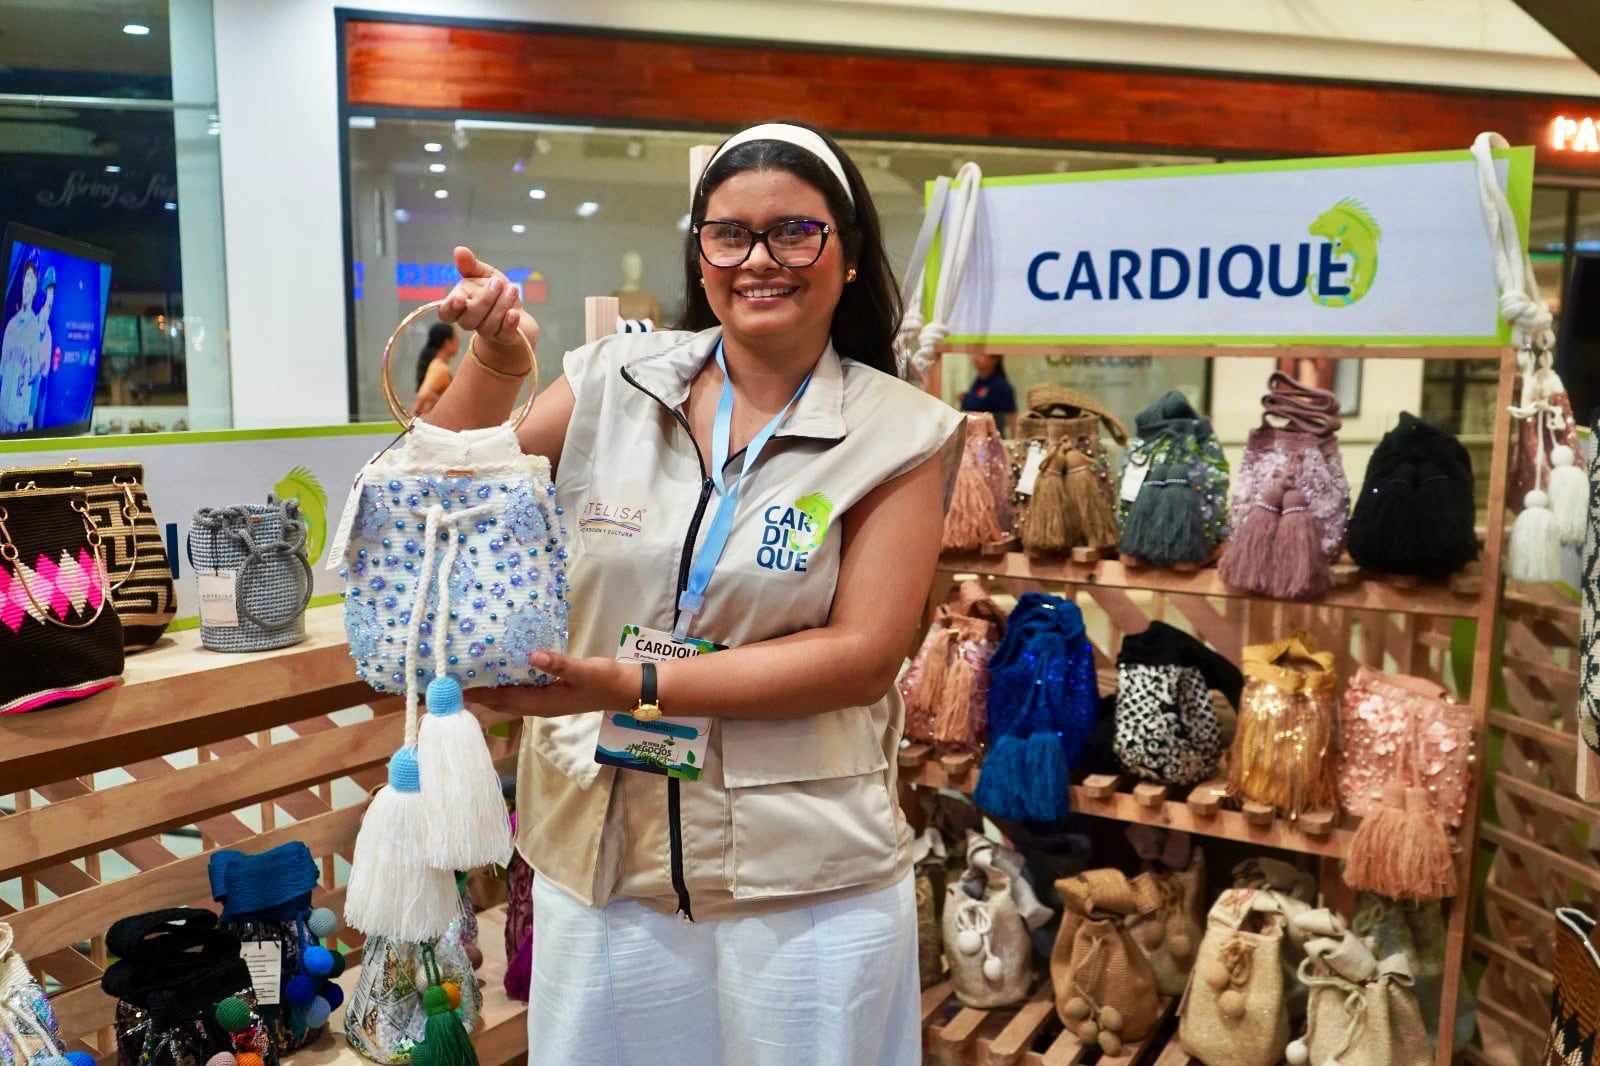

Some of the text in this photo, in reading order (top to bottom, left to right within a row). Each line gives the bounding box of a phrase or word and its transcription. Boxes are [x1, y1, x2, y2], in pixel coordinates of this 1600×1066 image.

[1552, 115, 1600, 152] PA
[1027, 243, 1351, 301] CARDIQUE
[756, 546, 809, 573] QUE
[635, 639, 702, 659] CARDIQU
[636, 720, 675, 733] Expositor
[629, 743, 673, 757] NEGOCIOS
